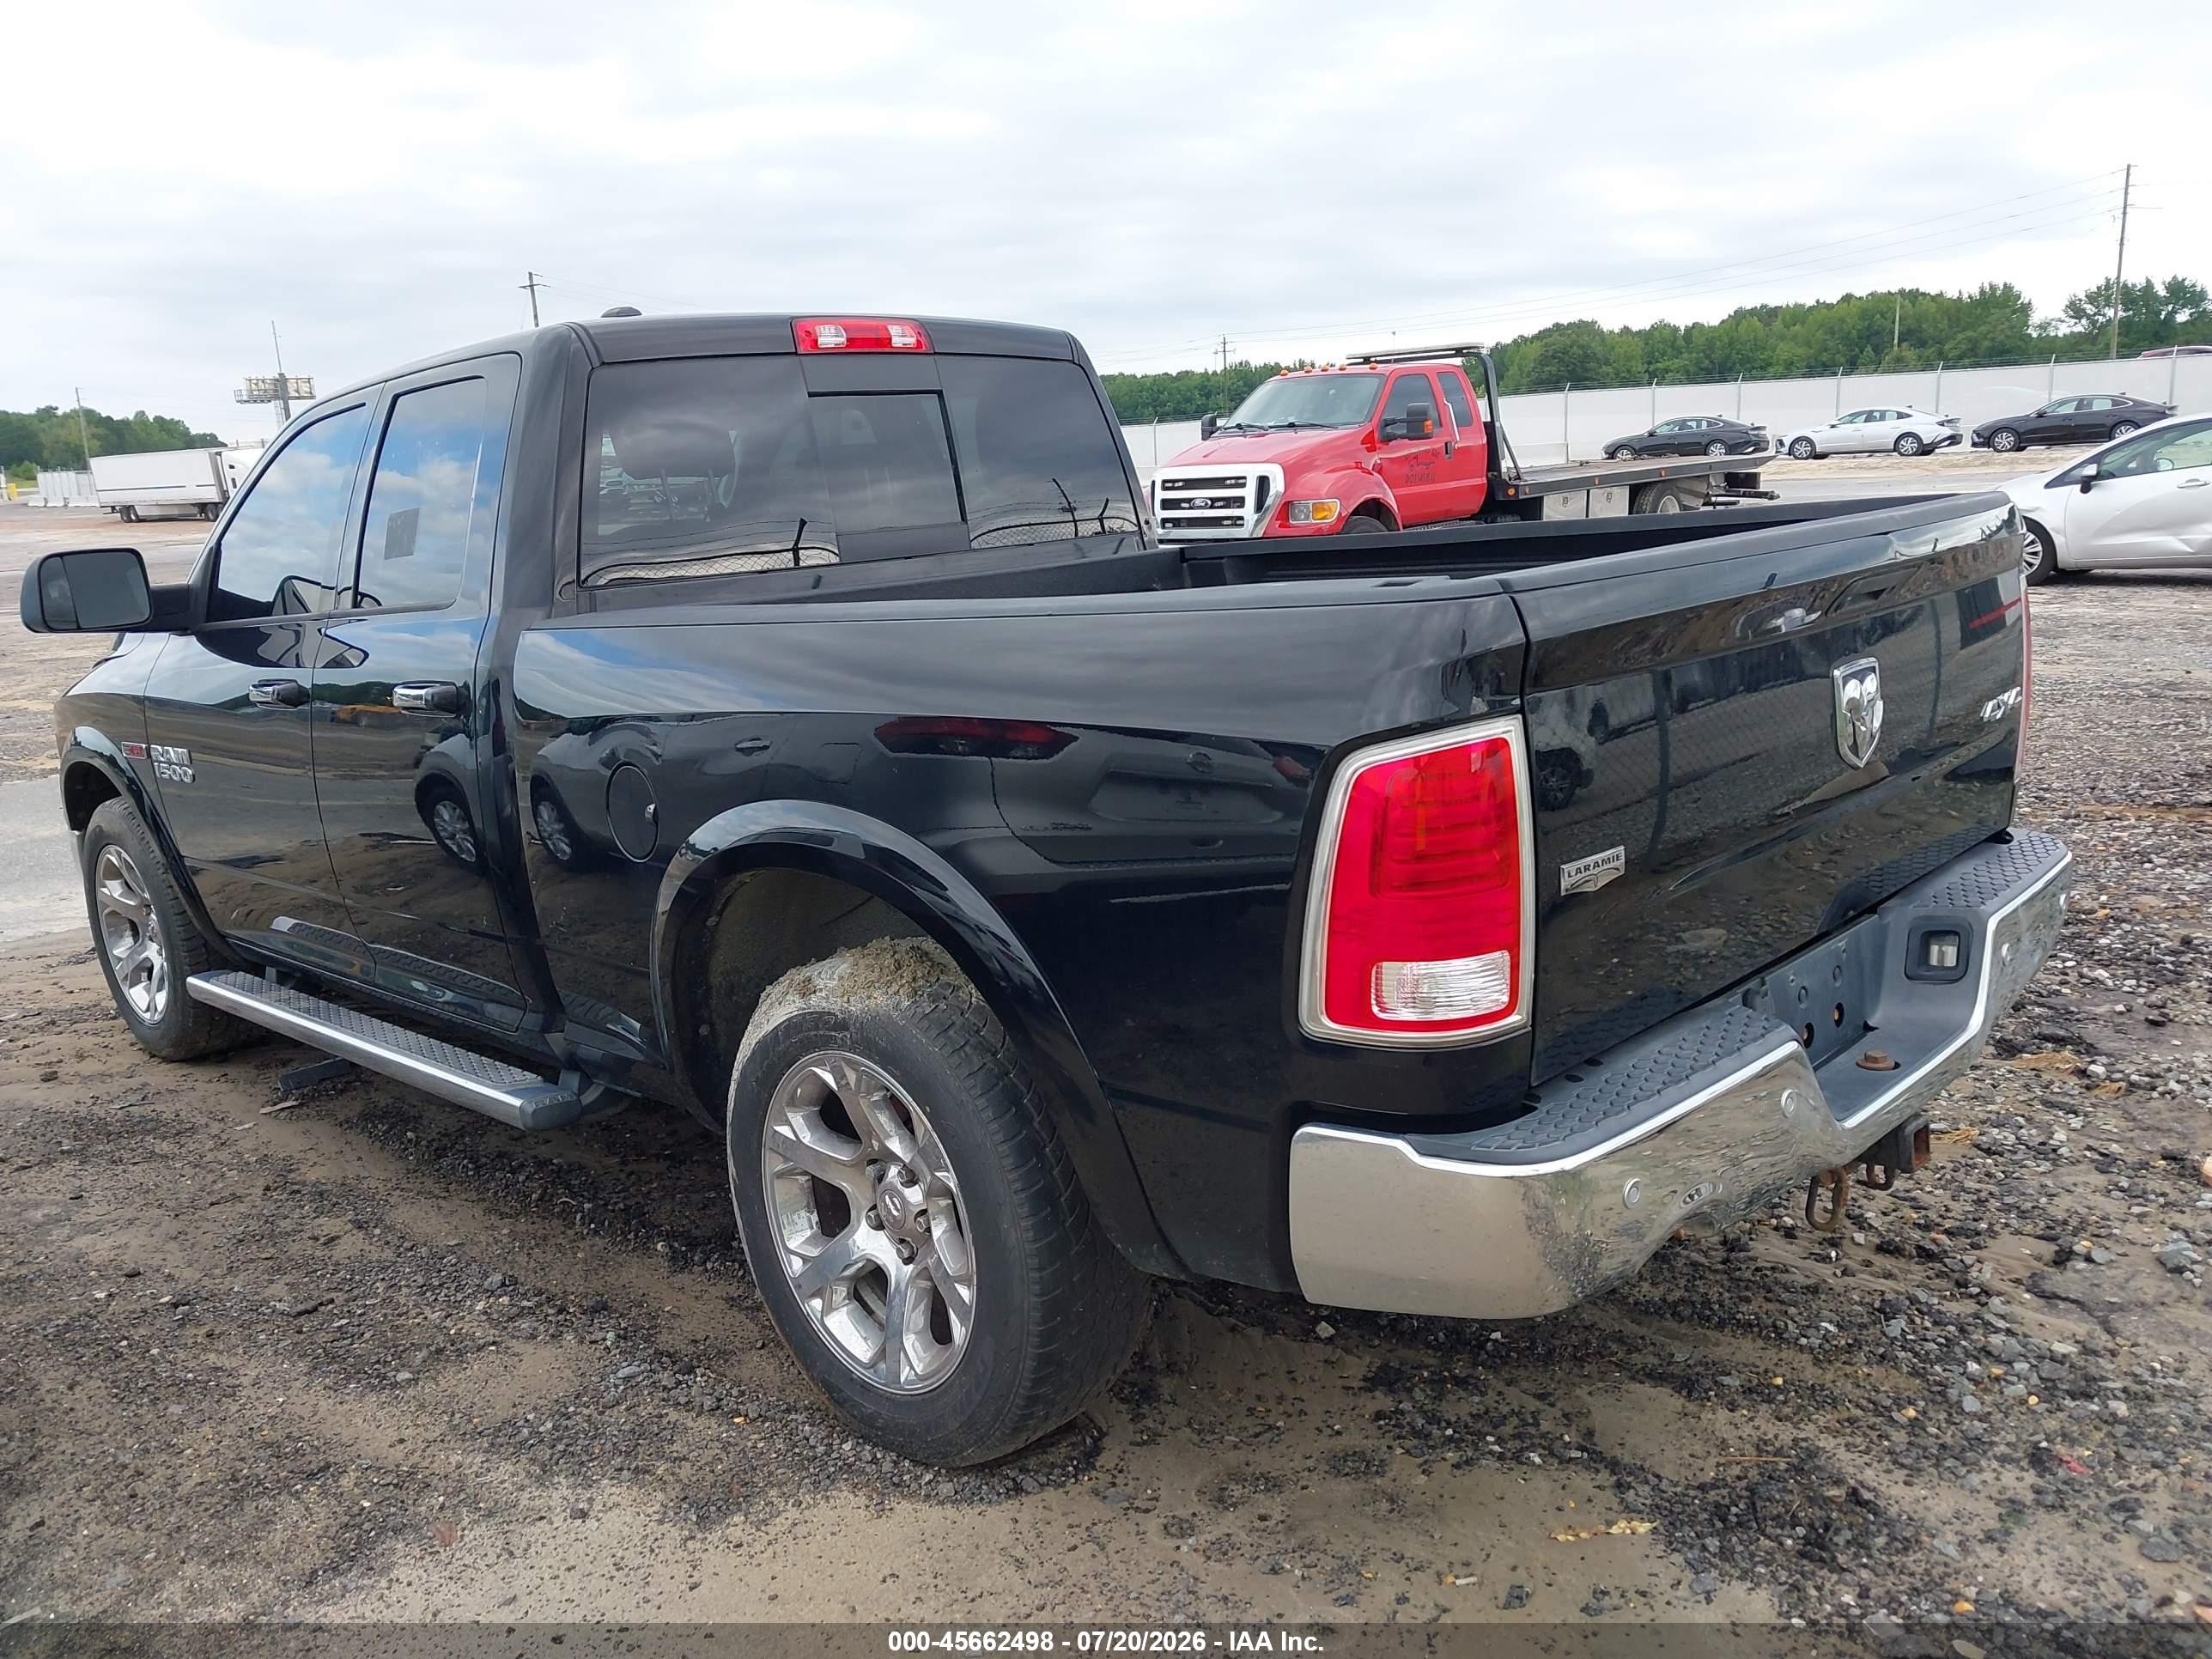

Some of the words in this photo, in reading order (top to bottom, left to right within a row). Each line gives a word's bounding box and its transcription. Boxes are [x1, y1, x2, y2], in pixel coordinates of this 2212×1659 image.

[149, 744, 191, 765] RAM
[154, 762, 195, 783] 1500
[1567, 852, 1623, 878] LARAMIE
